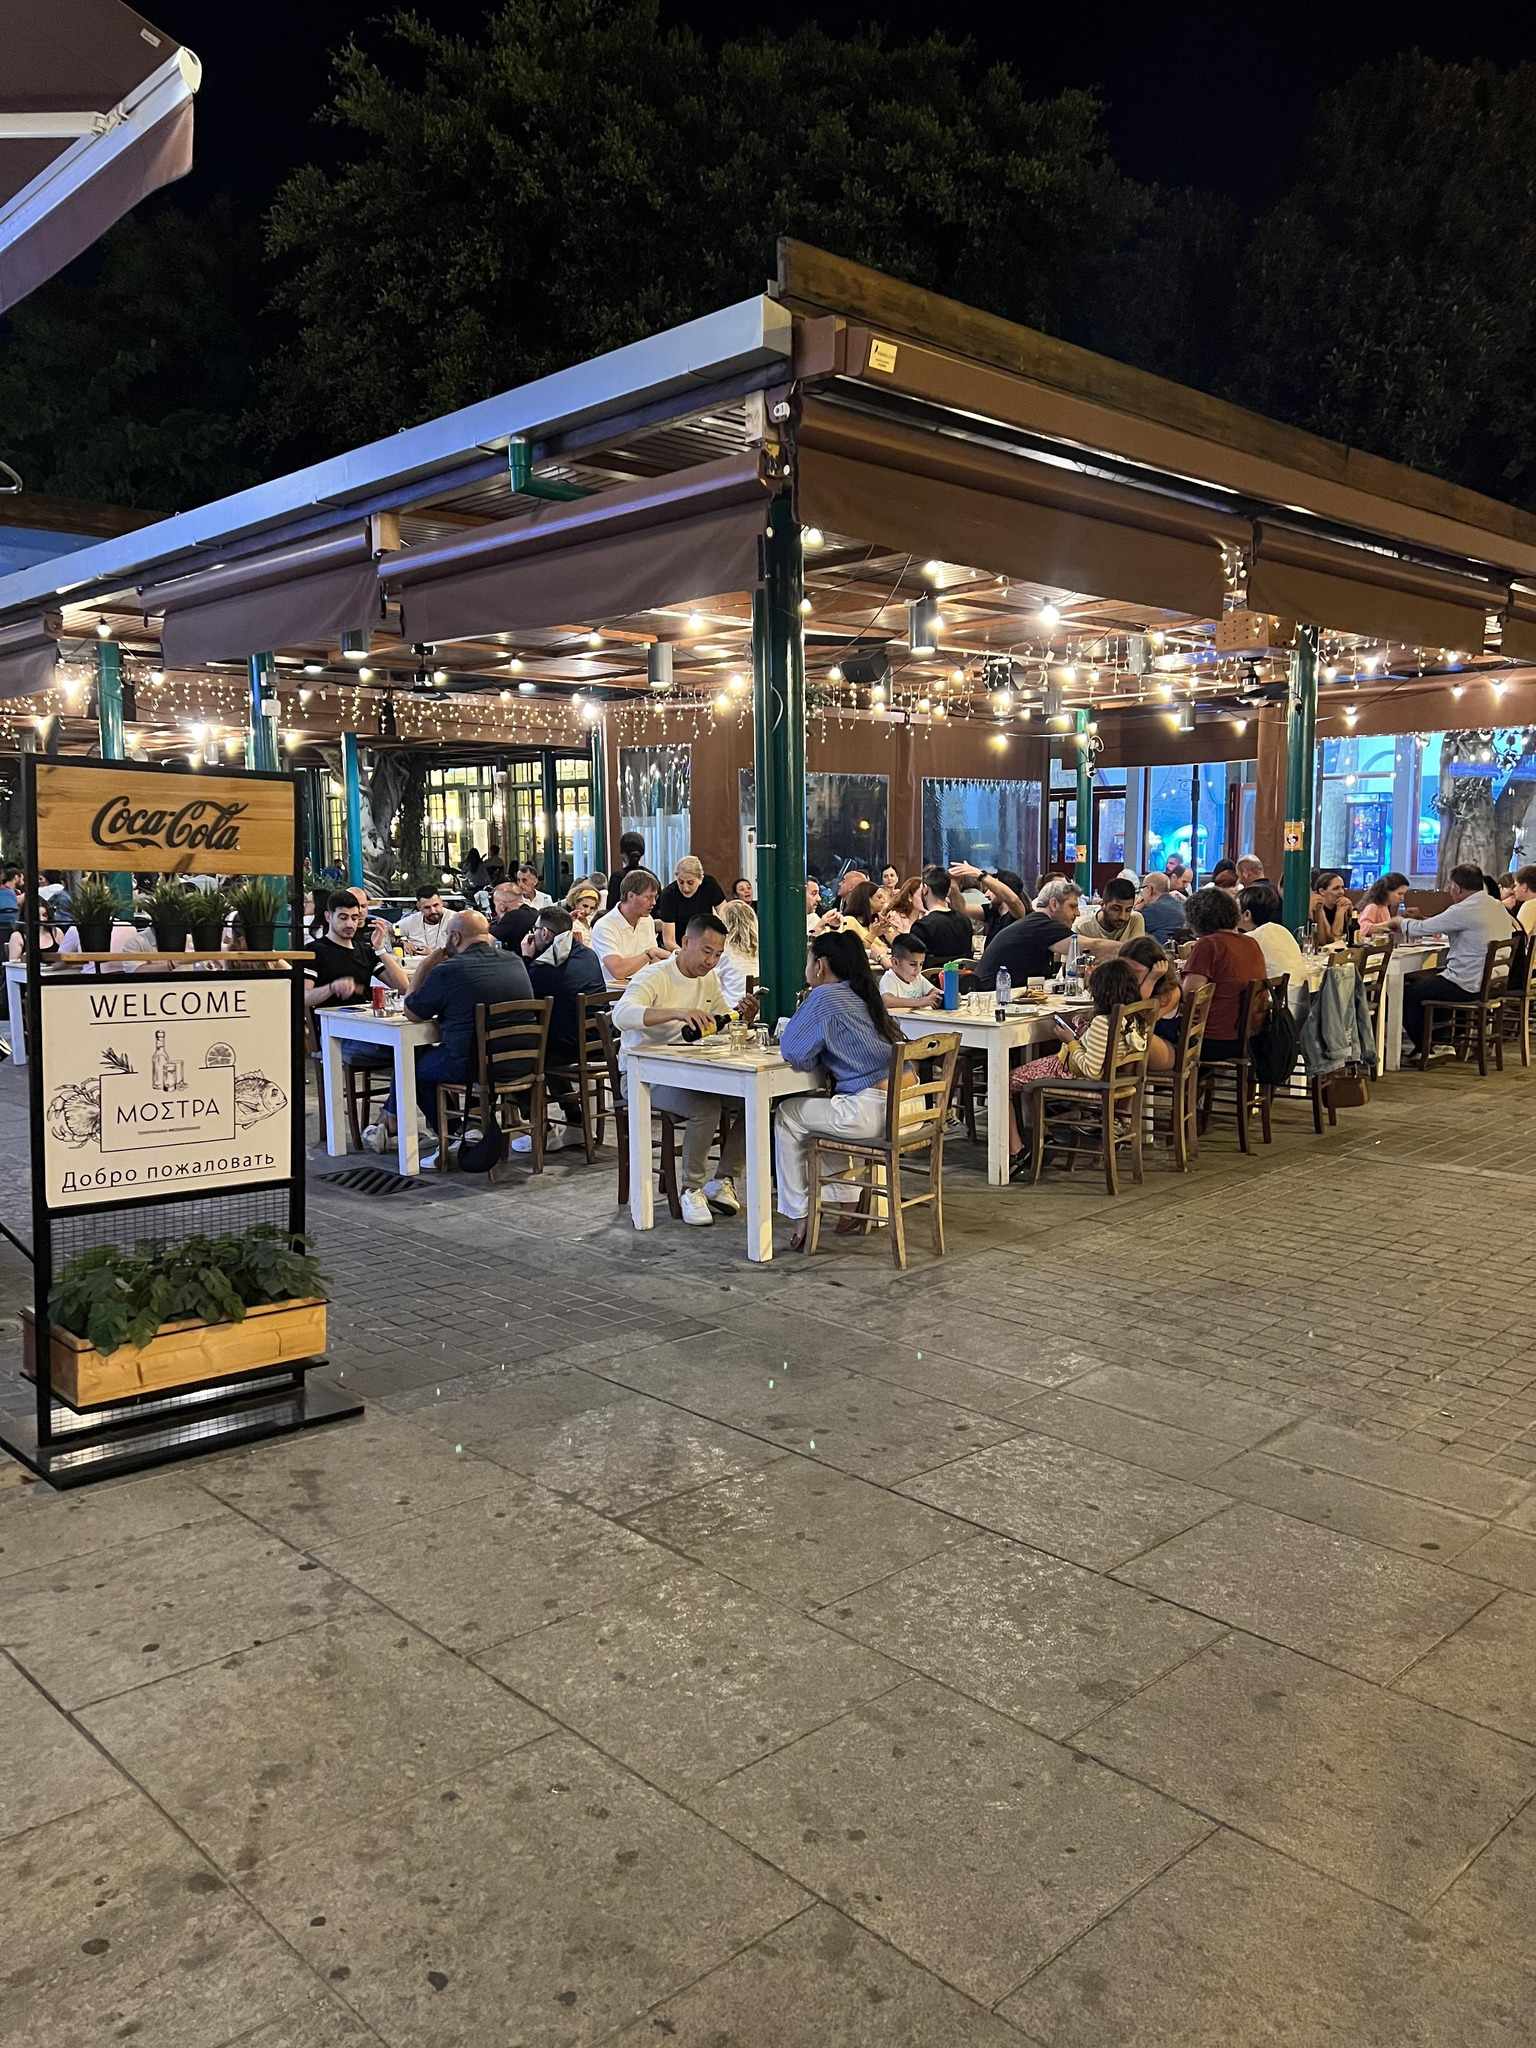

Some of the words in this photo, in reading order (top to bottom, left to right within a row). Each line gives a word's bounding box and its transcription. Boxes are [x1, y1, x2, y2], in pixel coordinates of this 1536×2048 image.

[91, 796, 248, 850] Coca-Cola
[90, 990, 247, 1018] WELCOME
[117, 1098, 220, 1124] ΜΟΣΤΡΑ
[62, 1167, 137, 1193] Добро
[147, 1153, 275, 1179] пожаловать
